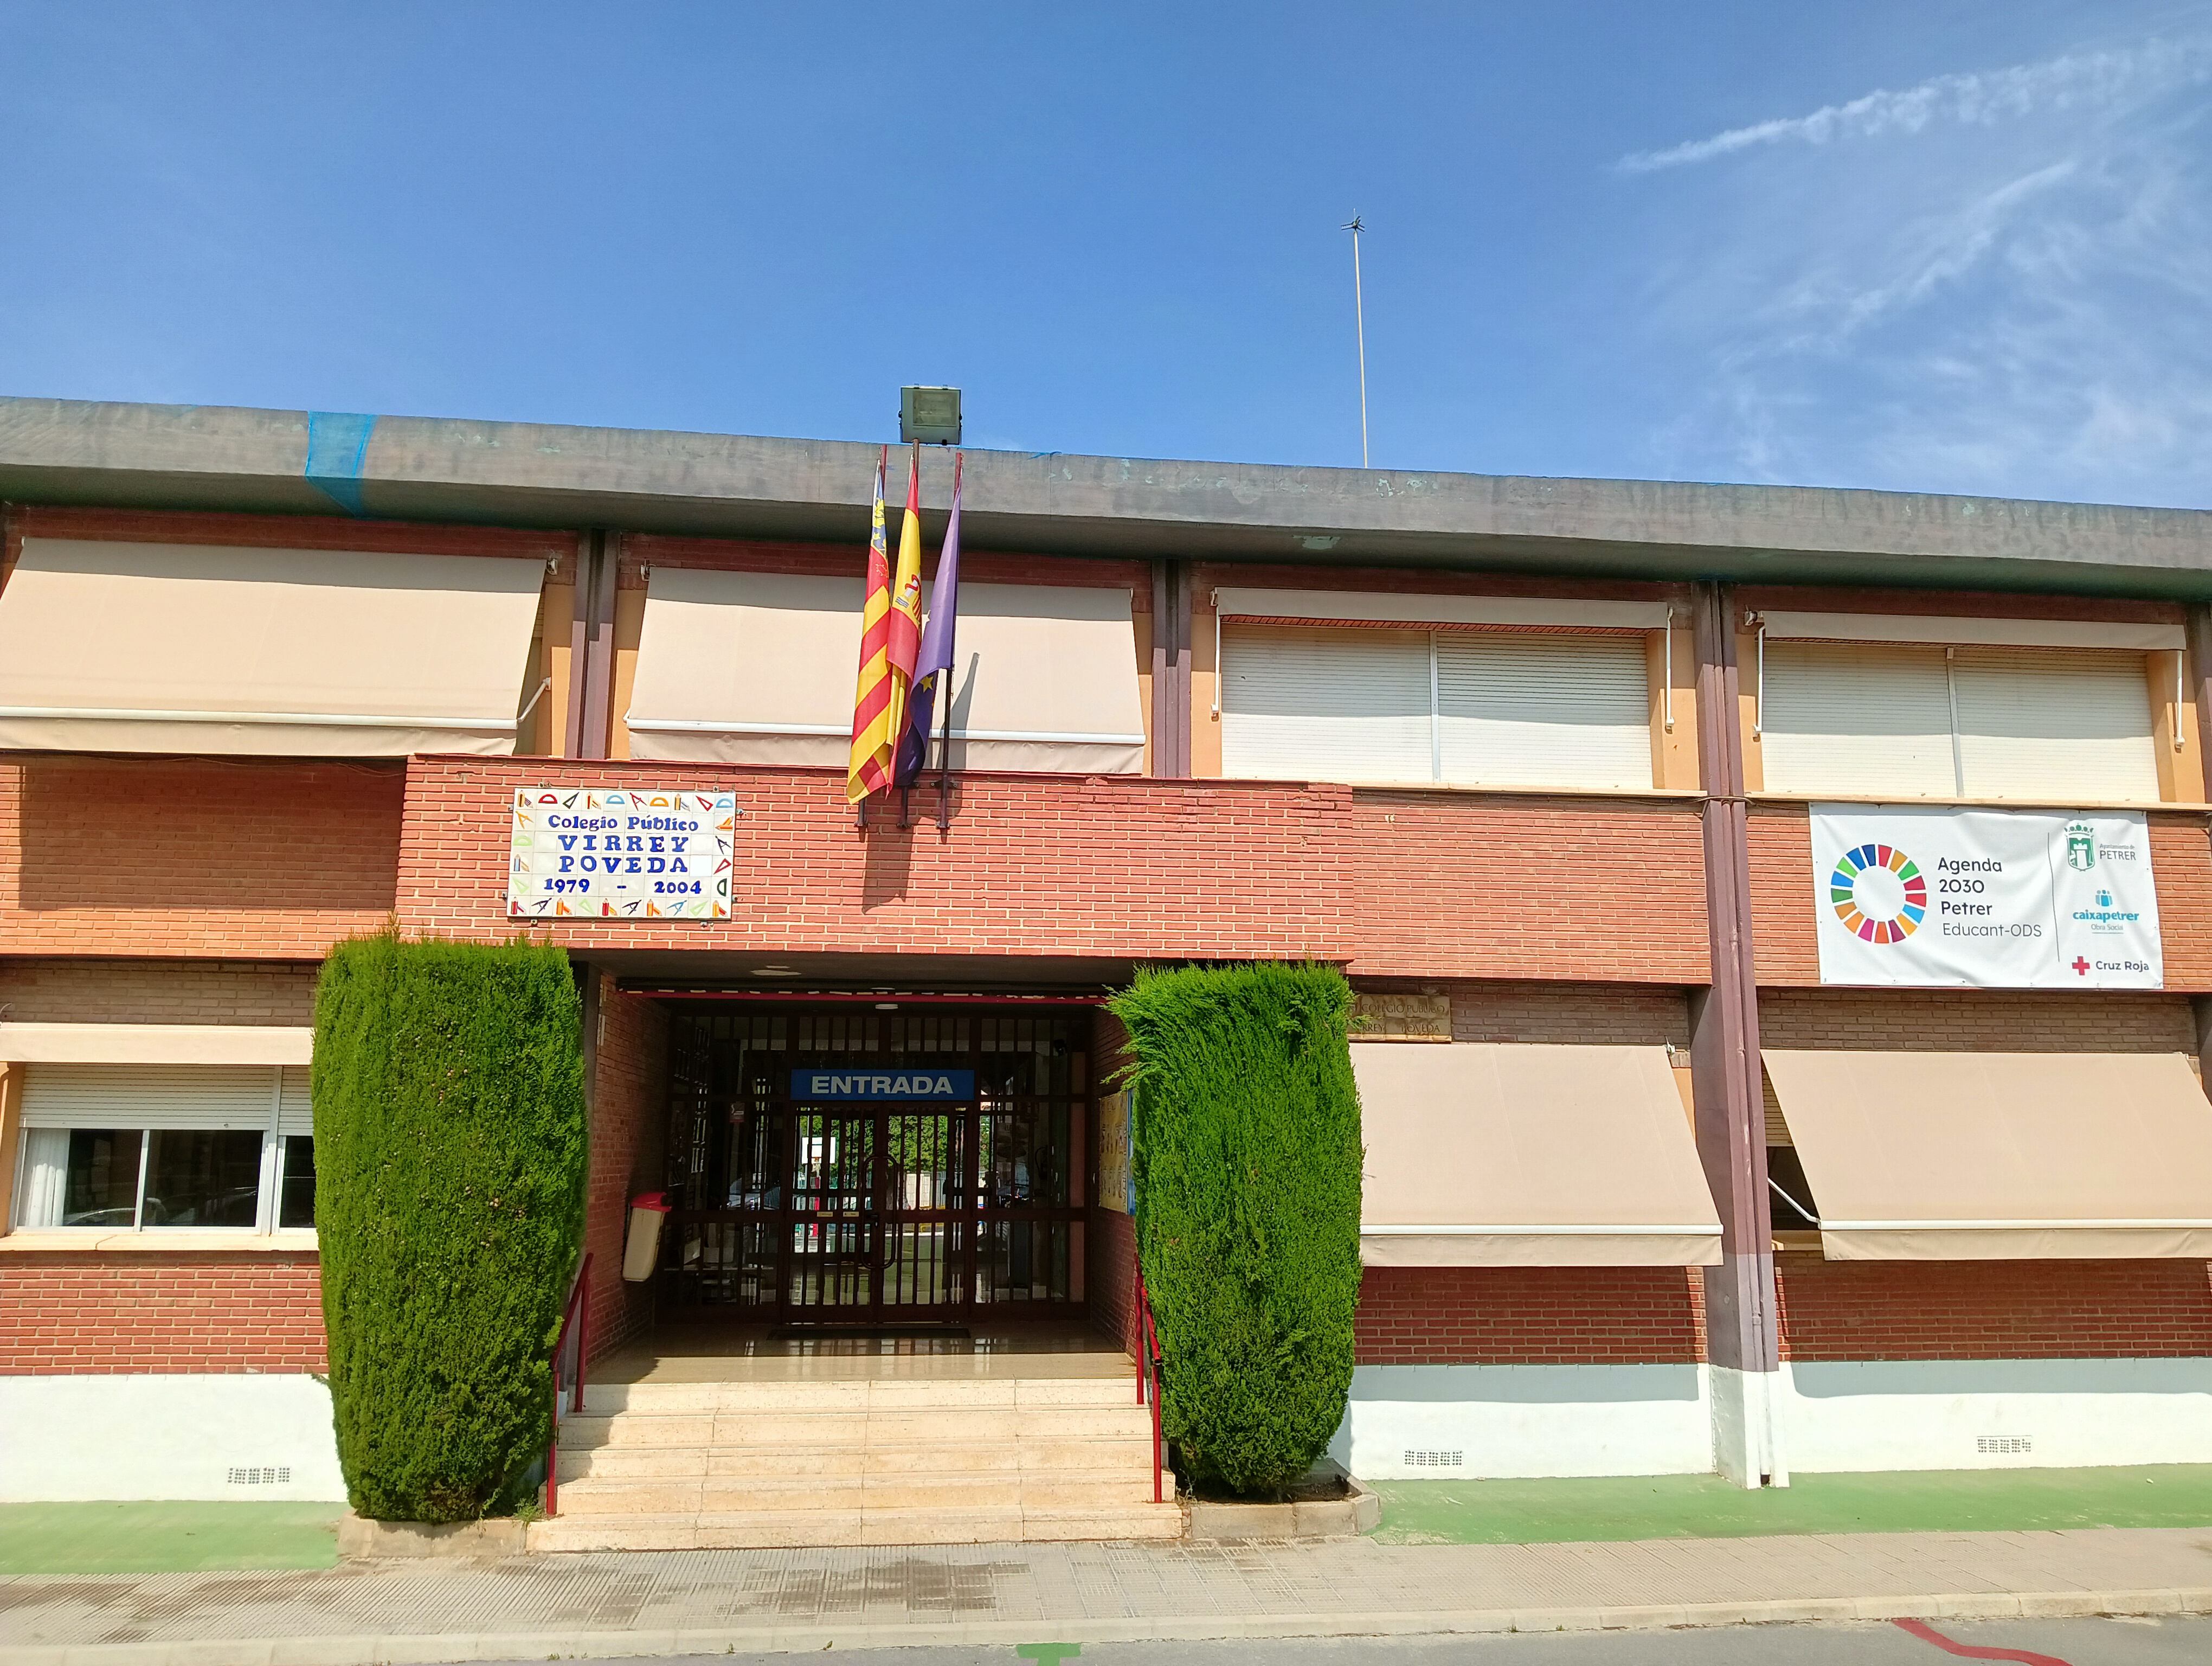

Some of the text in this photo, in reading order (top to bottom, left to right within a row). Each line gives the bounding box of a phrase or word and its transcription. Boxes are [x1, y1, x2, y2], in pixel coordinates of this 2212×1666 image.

[548, 815, 698, 831] Colegio Público
[558, 835, 689, 852] VIRREY
[2100, 850, 2136, 860] PETRER
[558, 856, 688, 873] POVEDA
[1938, 857, 2002, 875] Agenda
[544, 879, 590, 893] 1979
[654, 881, 702, 894] 2004
[1939, 879, 1984, 893] 2030
[1941, 901, 1992, 915] Petrer
[2073, 909, 2139, 923] caixapetrer
[1943, 922, 2042, 937] Educant-ODS
[2095, 960, 2149, 972] Cruz Roja
[812, 1076, 954, 1094] ENTRADA
